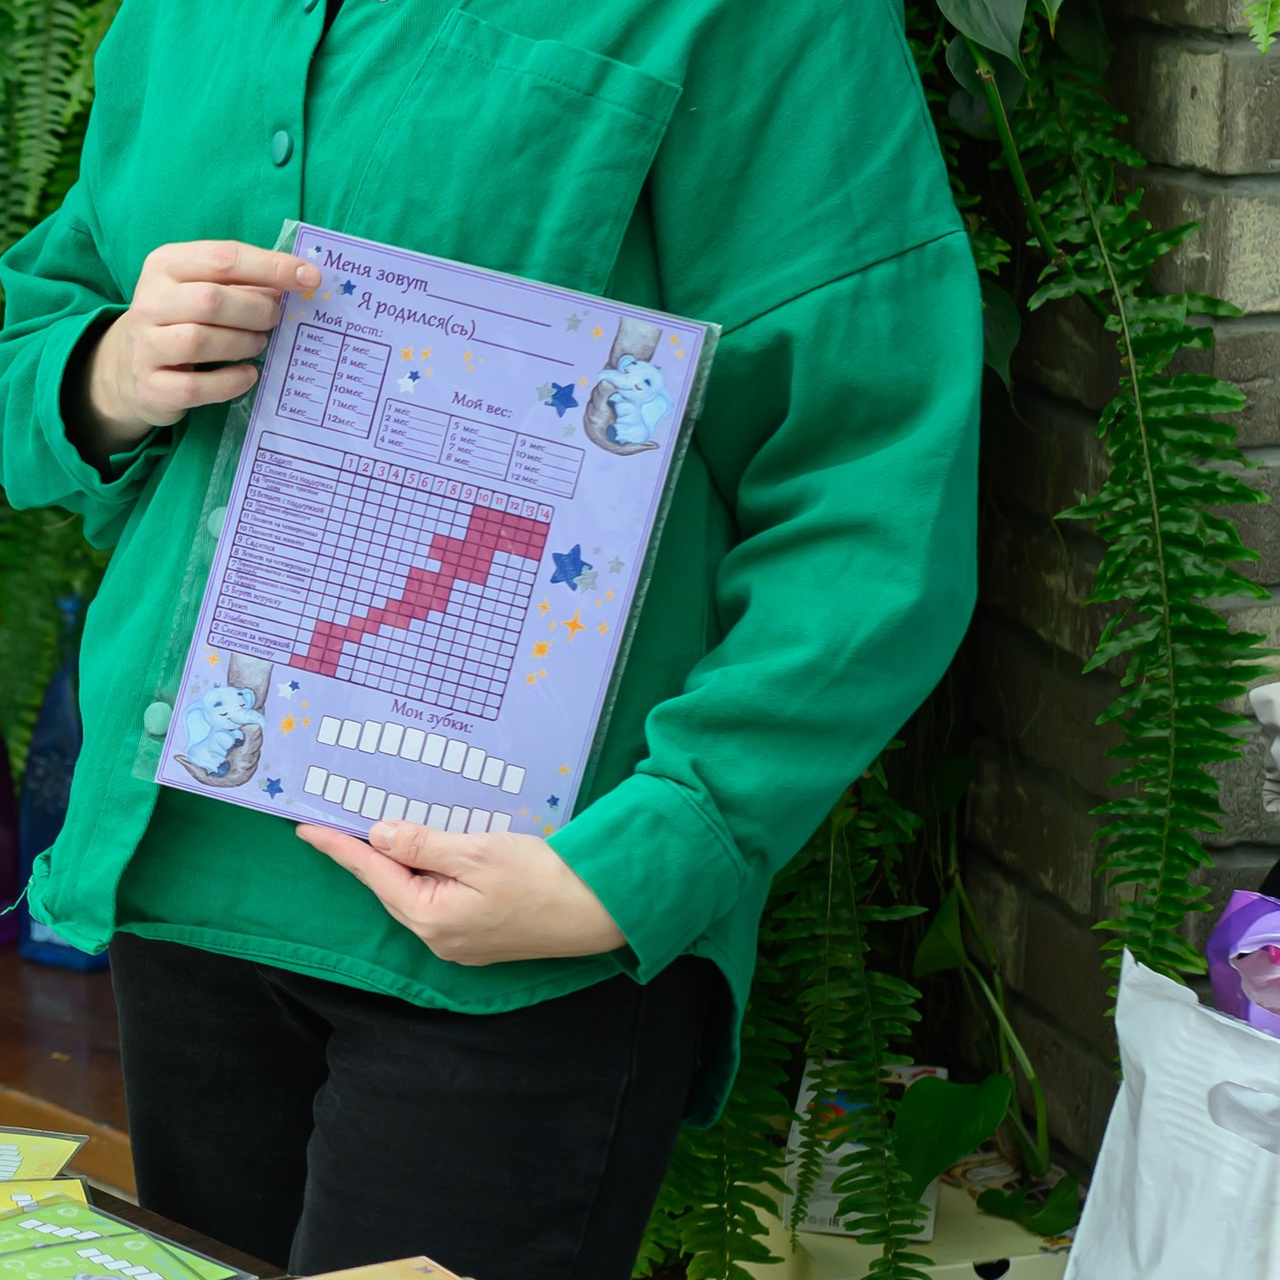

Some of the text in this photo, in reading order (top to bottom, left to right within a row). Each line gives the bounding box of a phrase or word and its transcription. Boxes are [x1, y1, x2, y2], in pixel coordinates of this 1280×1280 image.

[323, 249, 429, 296] Меня зовут
[357, 291, 476, 341] Я родился(сь)
[312, 309, 384, 338] Мой рост:
[300, 330, 324, 343] 1 мес
[303, 346, 321, 356] мес
[343, 343, 370, 356] 7 мес
[291, 358, 319, 370] 3 мес
[340, 355, 368, 370] 8 мес
[287, 372, 316, 385] 4 мес
[336, 371, 364, 384] 9 мес
[284, 387, 312, 401] 5 мес
[280, 402, 307, 417] 6 мес
[393, 407, 411, 417] мес
[451, 391, 513, 419] Мой вес:
[384, 414, 410, 427] 2 мес
[382, 424, 407, 437] 3 мес
[452, 421, 480, 435] 5 мес
[379, 434, 404, 448] 4 мес
[449, 432, 477, 446] 6 мес
[519, 438, 546, 452] 9 мес
[448, 442, 474, 456] 7 мес
[445, 453, 471, 466] 8 мес
[348, 458, 550, 521] 1 2 3 4 5 6 7 8 9 10 11 12 13 14
[390, 698, 474, 734] Мои зубки:
